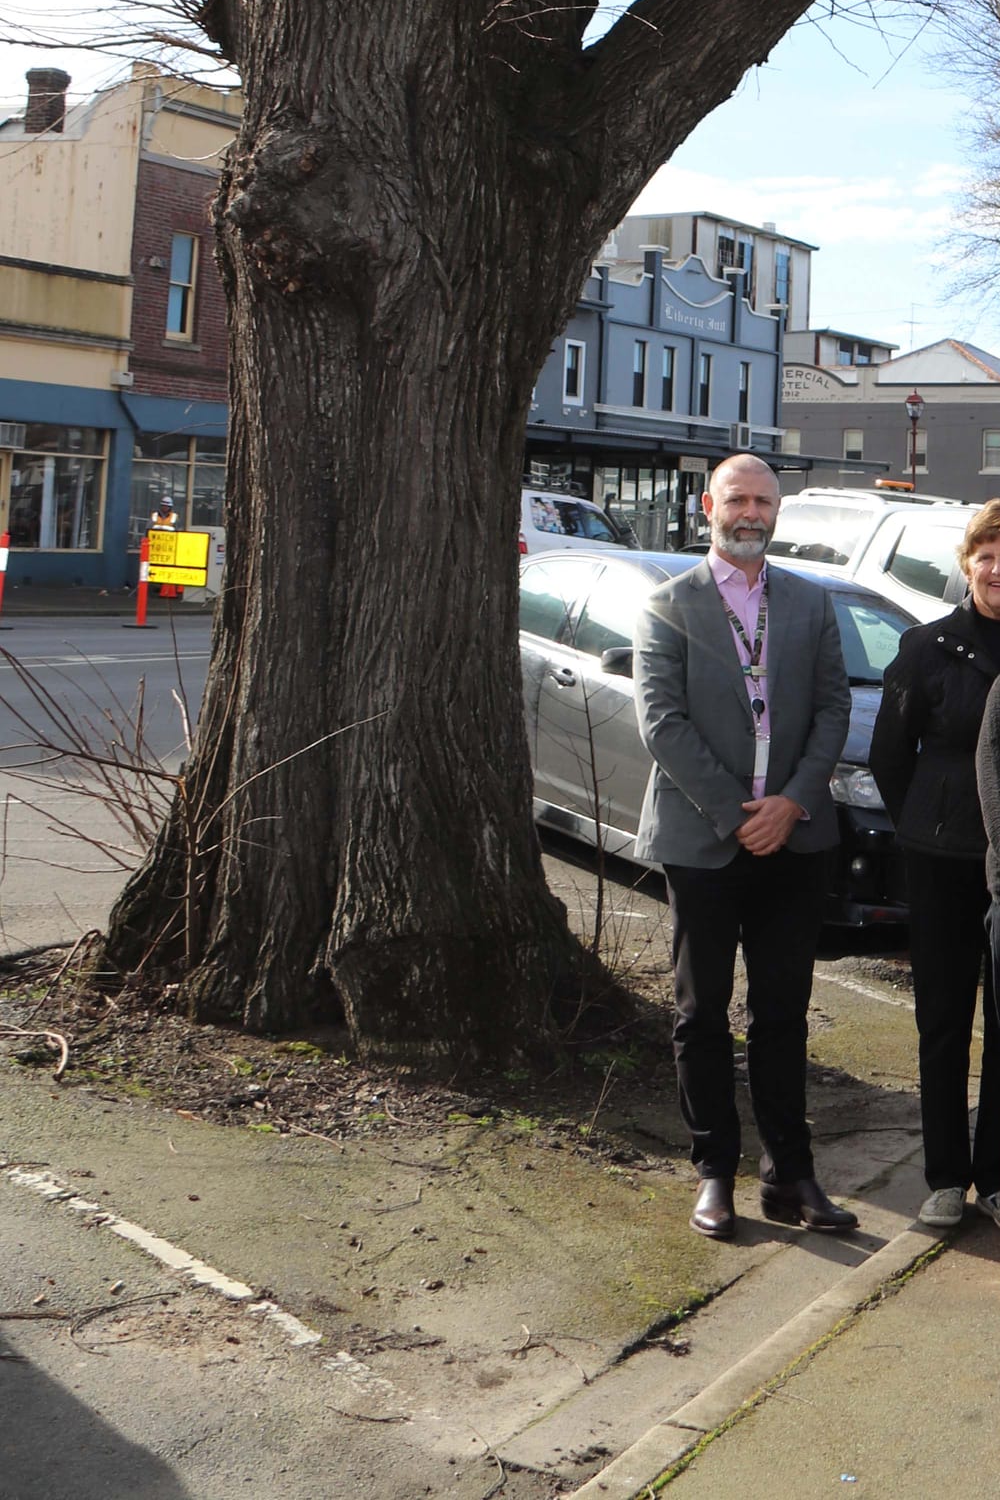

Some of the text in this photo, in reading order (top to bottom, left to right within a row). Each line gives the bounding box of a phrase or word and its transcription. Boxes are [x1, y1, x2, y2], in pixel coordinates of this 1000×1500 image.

[665, 303, 726, 332] Liberty Inn
[782, 370, 829, 389] ERCIAL
